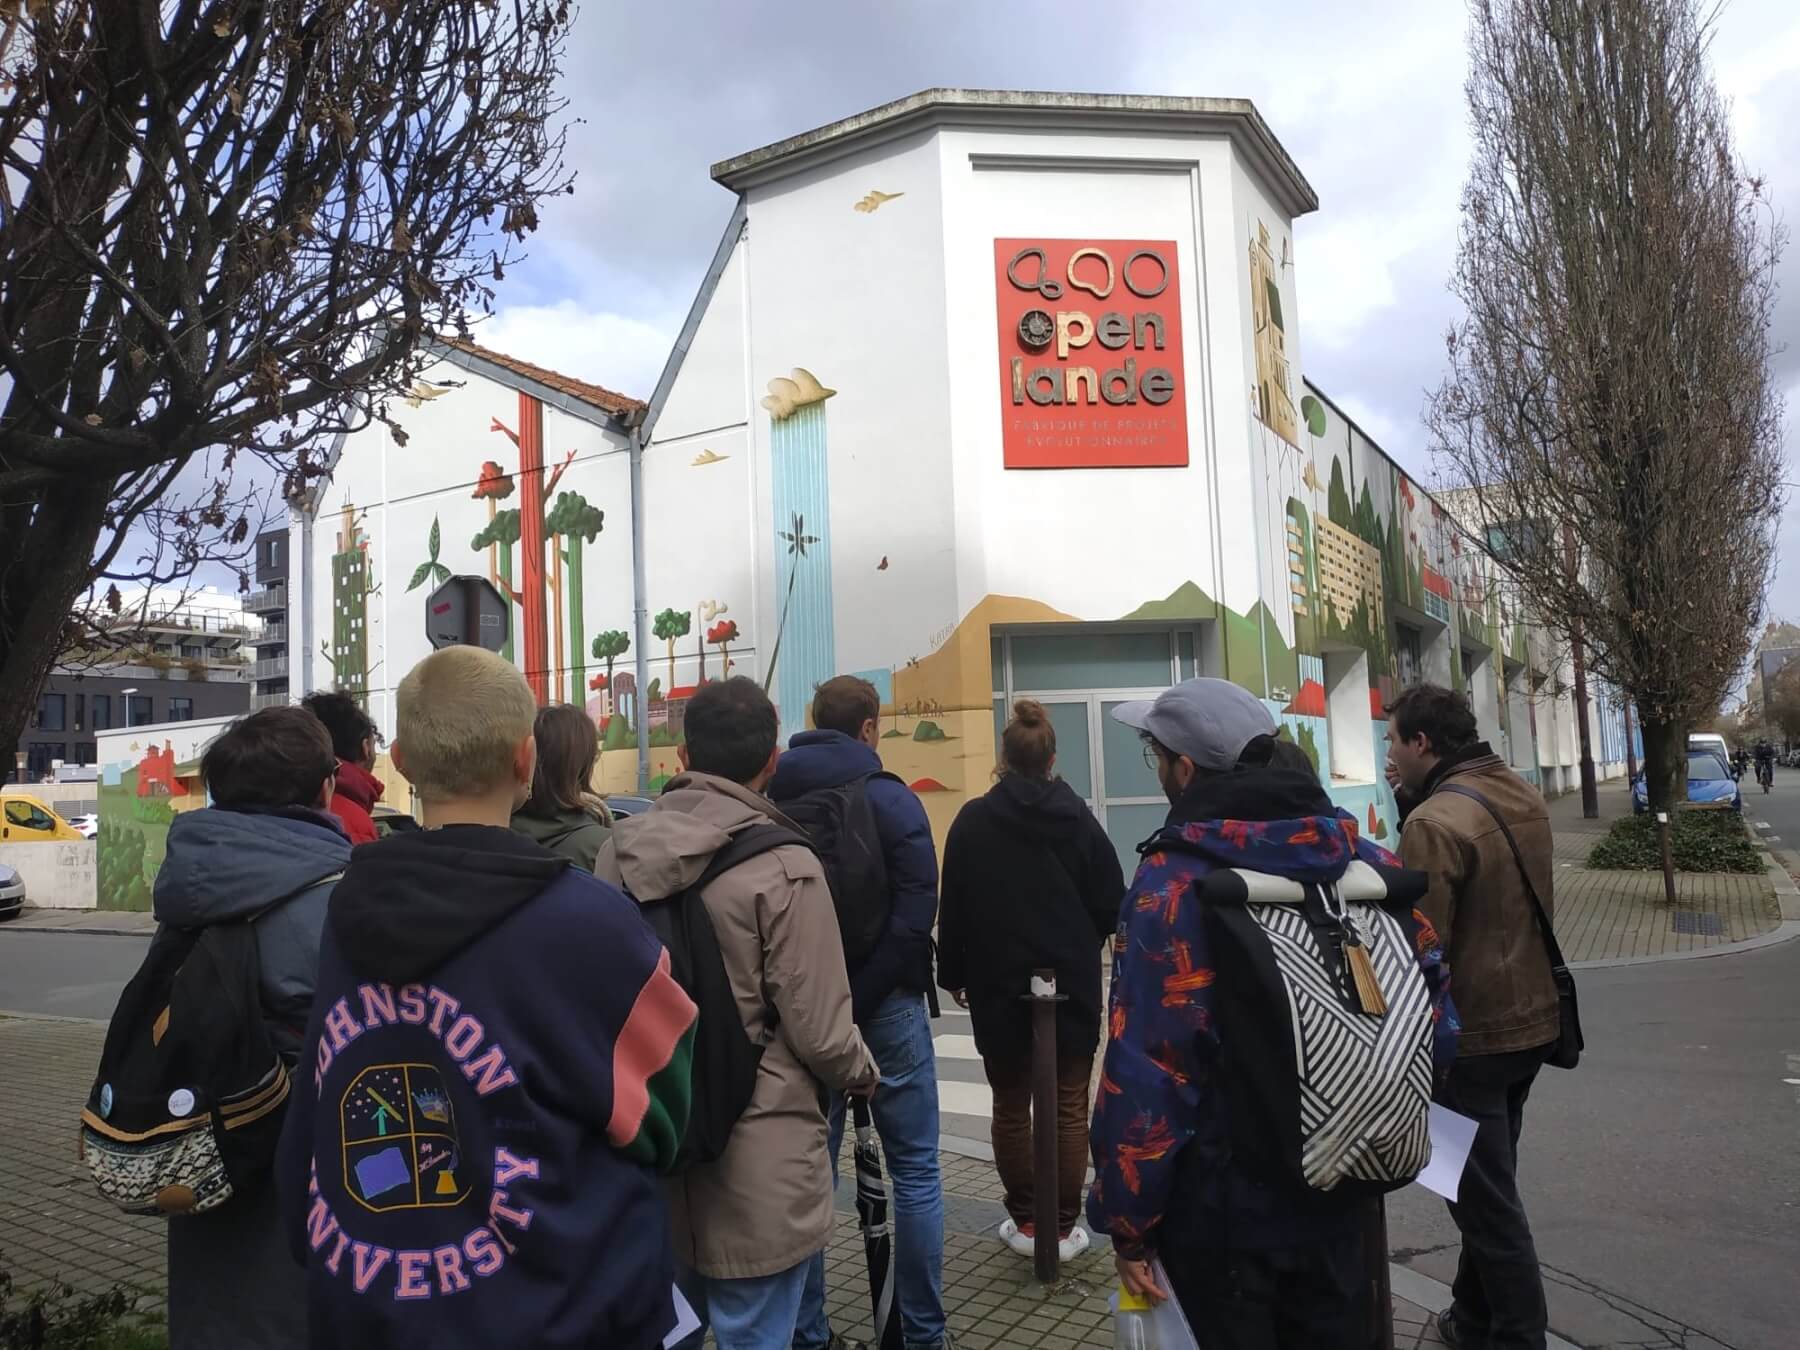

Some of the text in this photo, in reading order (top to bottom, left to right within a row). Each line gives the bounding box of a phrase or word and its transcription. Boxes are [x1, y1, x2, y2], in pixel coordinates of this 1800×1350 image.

[1018, 310, 1165, 359] open
[1010, 356, 1176, 405] lande
[315, 983, 519, 1100] OHNSTON
[307, 1146, 541, 1300] NIVERSITY
